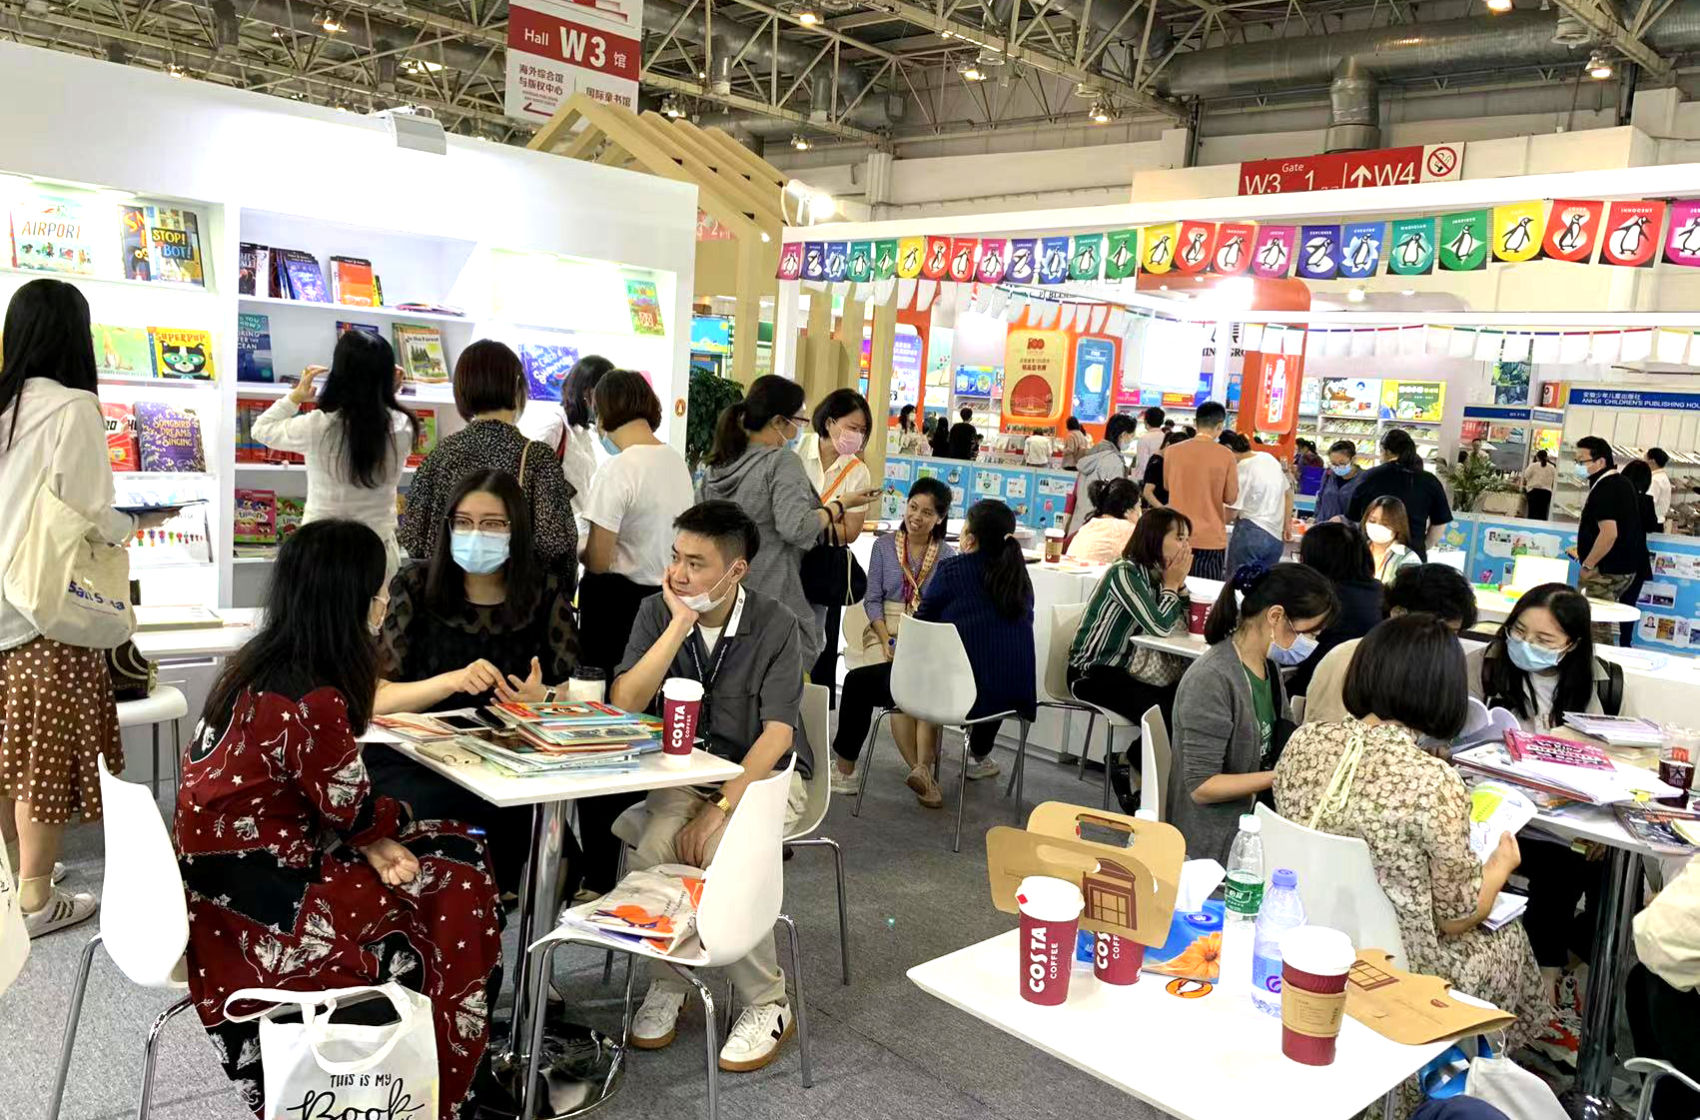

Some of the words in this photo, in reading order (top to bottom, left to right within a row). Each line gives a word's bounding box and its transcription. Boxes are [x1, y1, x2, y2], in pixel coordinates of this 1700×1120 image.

[524, 28, 549, 46] Hall
[560, 26, 606, 68] W3
[613, 51, 627, 69] 馆
[519, 63, 564, 84] 海外综合馆
[519, 76, 563, 96] 与版权中心
[1245, 173, 1281, 195] W3
[1281, 163, 1304, 173] Gate
[1305, 170, 1315, 191] 1
[1374, 162, 1415, 187] W4
[152, 230, 186, 245] STOP!
[163, 245, 192, 260] BOT!
[1644, 400, 1685, 408] PUBLISHING
[162, 436, 194, 448] SINGING
[671, 705, 686, 748] COSTA
[684, 715, 692, 739] COFFEE
[1097, 931, 1111, 970] COS
[1112, 934, 1121, 960] COFF
[1029, 927, 1048, 993] COSTA
[1050, 943, 1058, 979] COFFEE
[330, 1074, 355, 1088] THIS
[360, 1074, 371, 1087] IS
[375, 1073, 392, 1087] MY
[286, 1077, 425, 1120] Book
